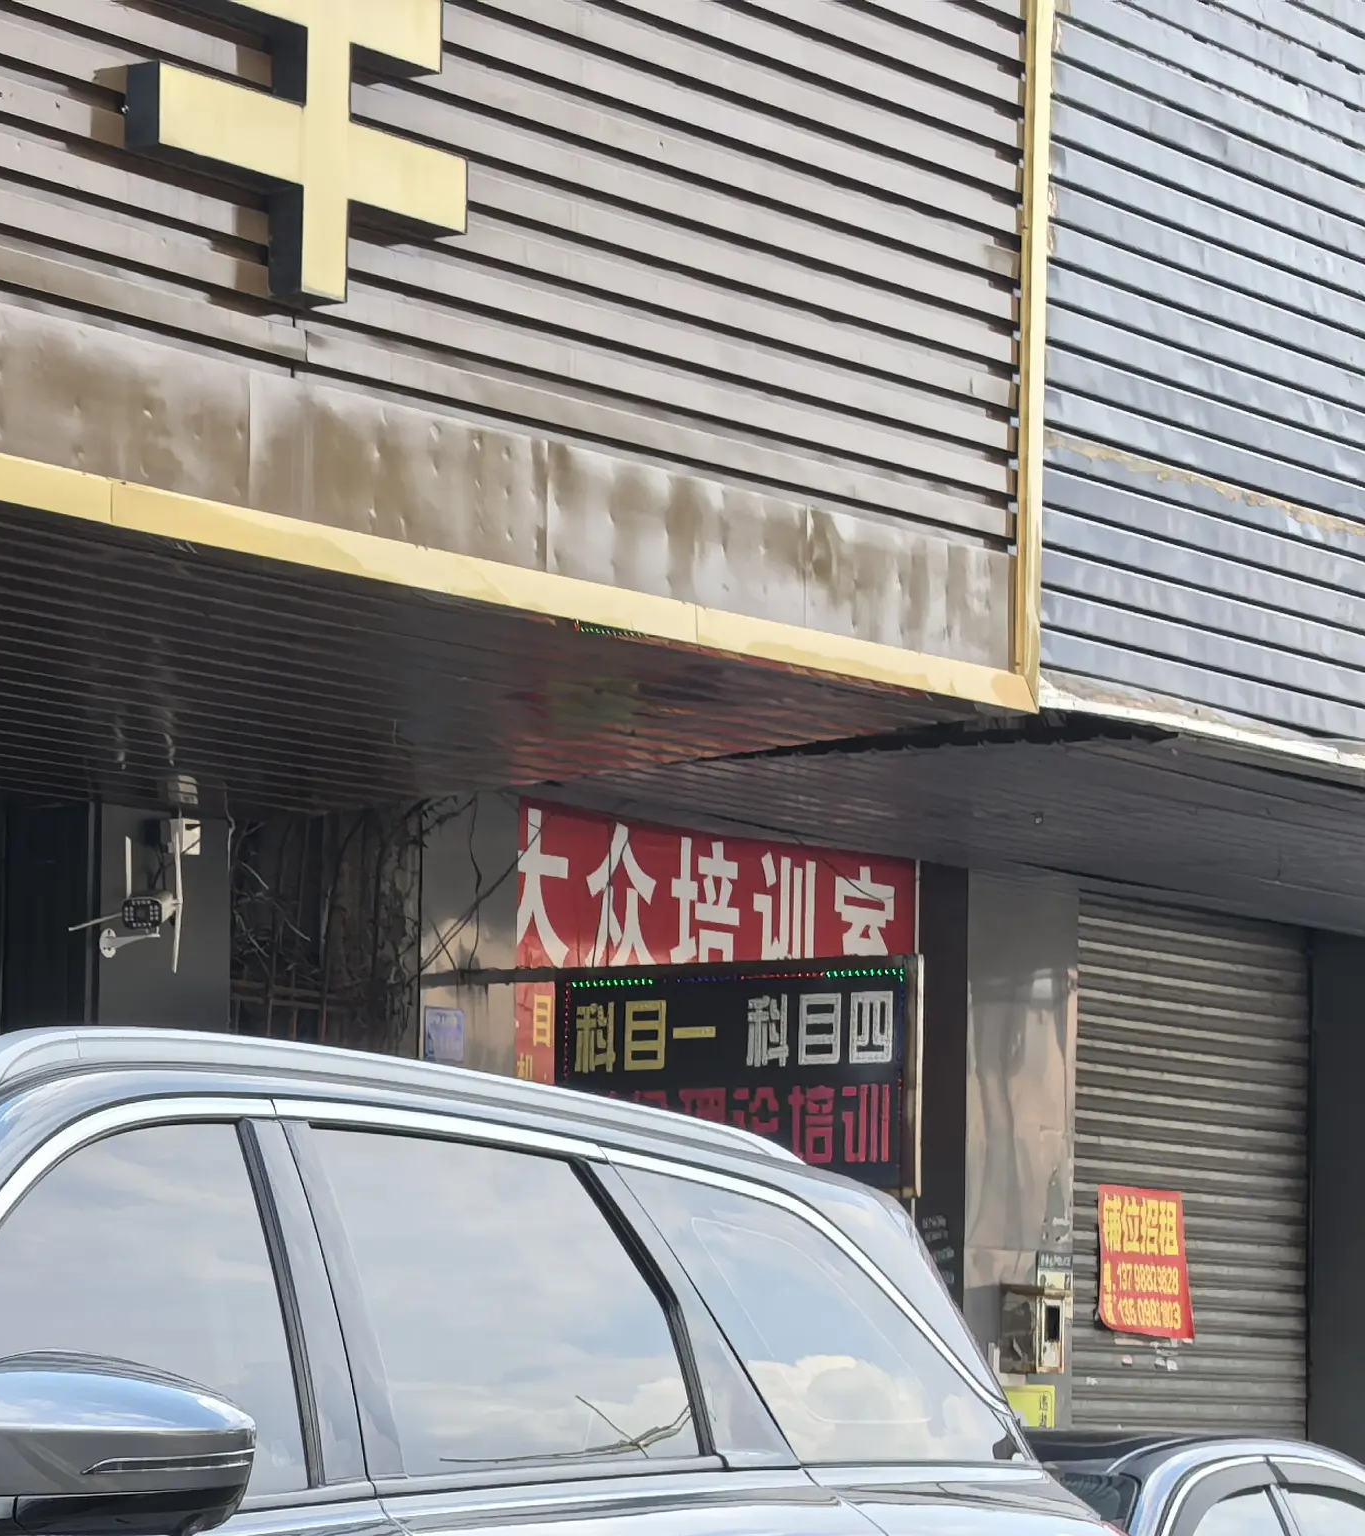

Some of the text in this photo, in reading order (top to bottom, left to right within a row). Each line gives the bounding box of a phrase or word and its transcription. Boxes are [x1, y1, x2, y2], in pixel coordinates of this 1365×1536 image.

[517, 808, 896, 967] 大众培训室
[574, 990, 894, 1073] 科目一 科目四
